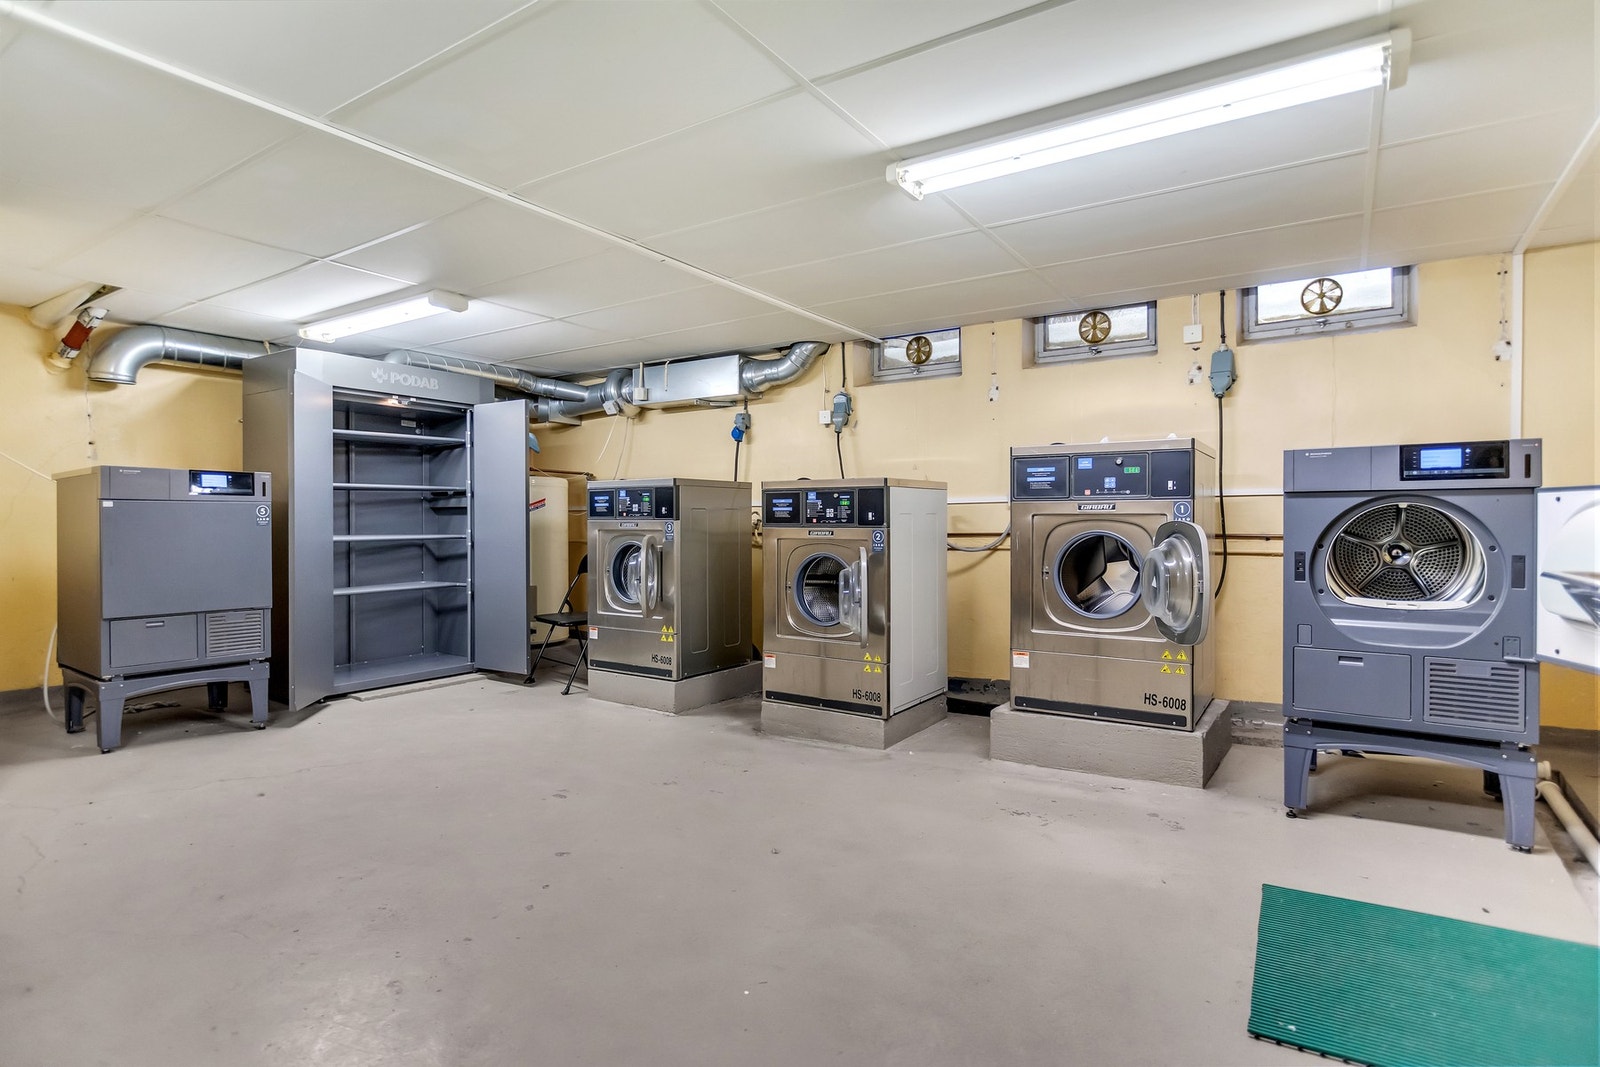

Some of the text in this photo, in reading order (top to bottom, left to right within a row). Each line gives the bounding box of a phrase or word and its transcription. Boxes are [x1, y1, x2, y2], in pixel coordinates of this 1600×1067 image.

[390, 372, 439, 390] PODAB
[852, 688, 881, 702] HS-6008
[1143, 692, 1187, 711] HS-6008
